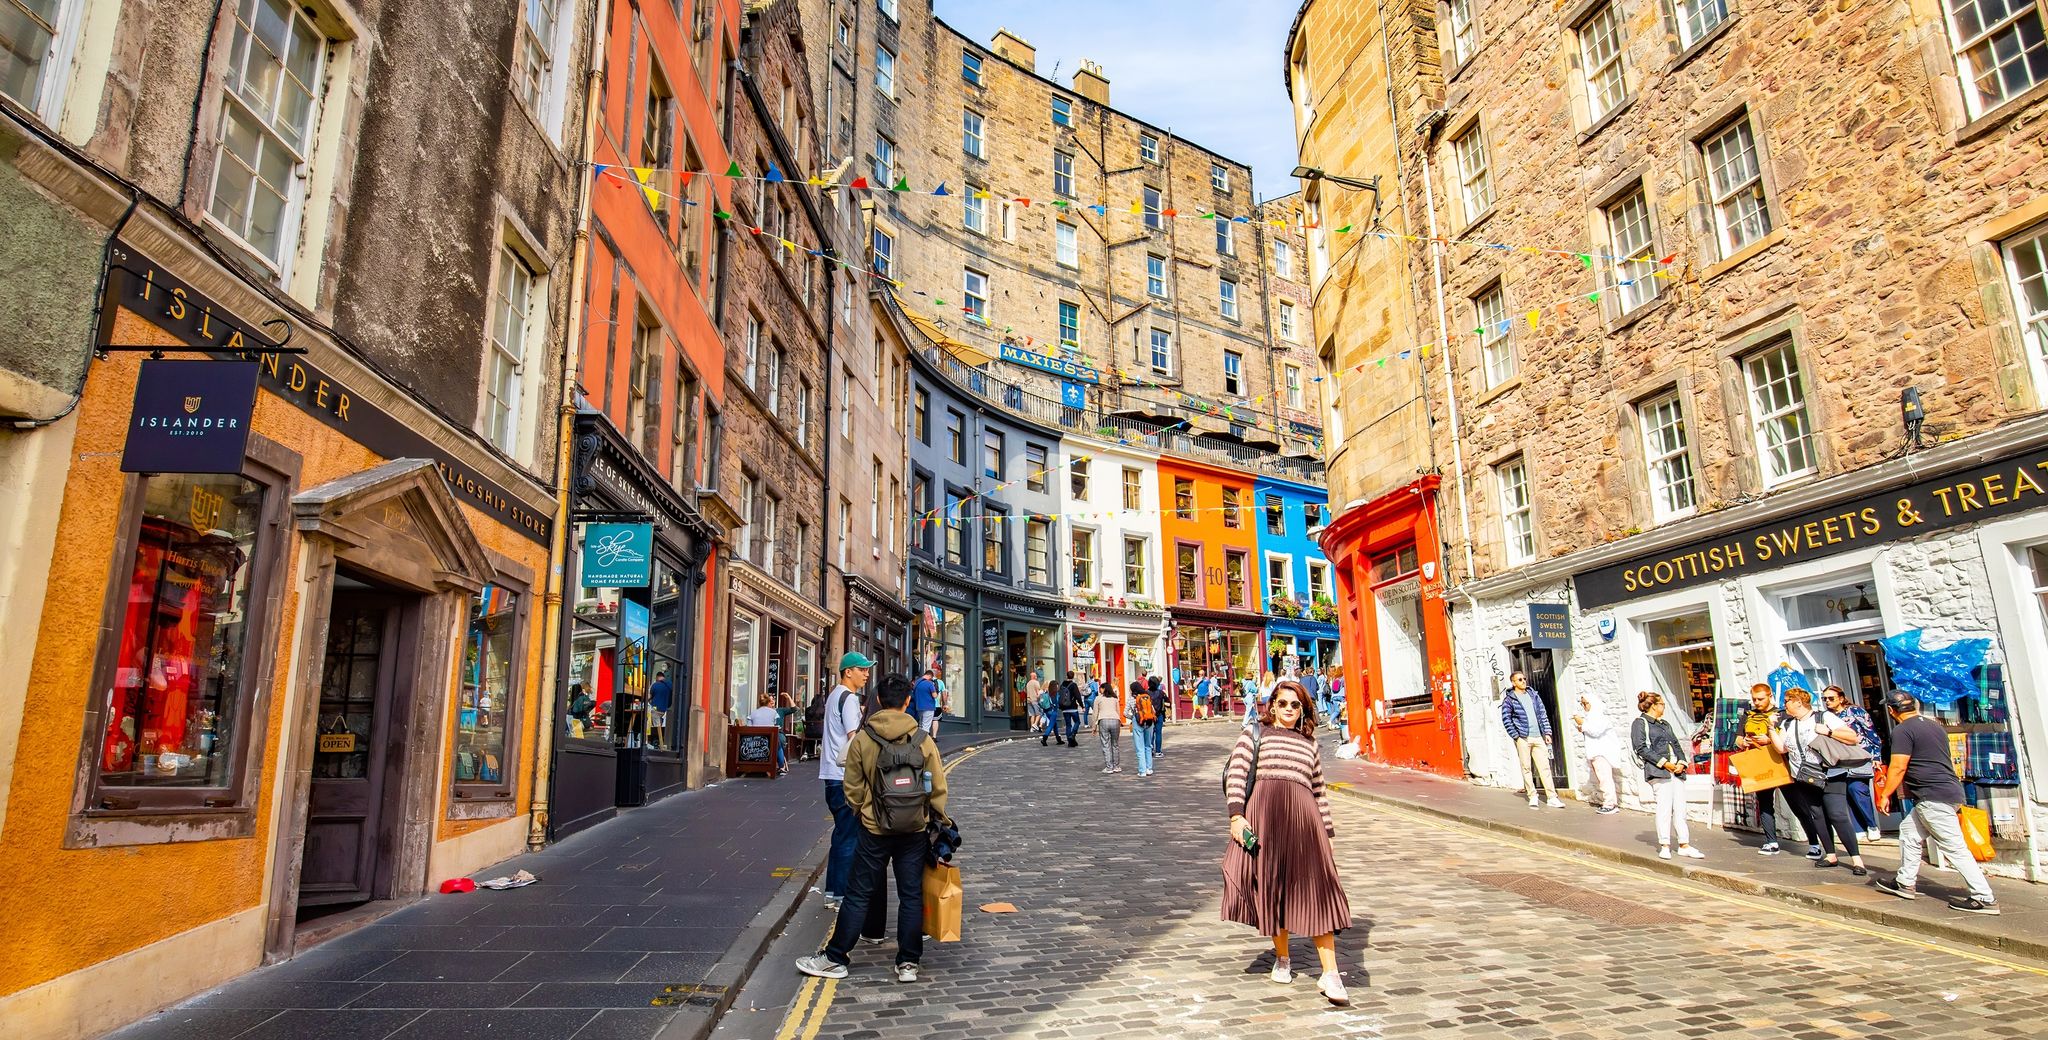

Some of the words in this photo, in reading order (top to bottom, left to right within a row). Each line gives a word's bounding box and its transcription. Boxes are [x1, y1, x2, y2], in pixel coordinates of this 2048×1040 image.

[144, 270, 350, 422] ISLANDER
[1003, 347, 1076, 375] MAXIES
[140, 417, 237, 428] ISLANDER
[595, 457, 604, 472] LE
[606, 466, 617, 481] OF
[618, 476, 636, 499] SKYE
[637, 493, 660, 520] CANDLE
[439, 462, 506, 512] FLAGSHIP
[511, 507, 545, 536] STORE
[1623, 542, 1745, 592] SCOTTISH
[1754, 507, 1880, 561] SWEETS
[1896, 498, 1923, 526] &
[732, 577, 743, 593] 89
[1205, 566, 1223, 586] 40
[1004, 602, 1035, 614] LADIESWEAR
[1540, 622, 1564, 630] SWEETS
[323, 740, 351, 748] OPEN
